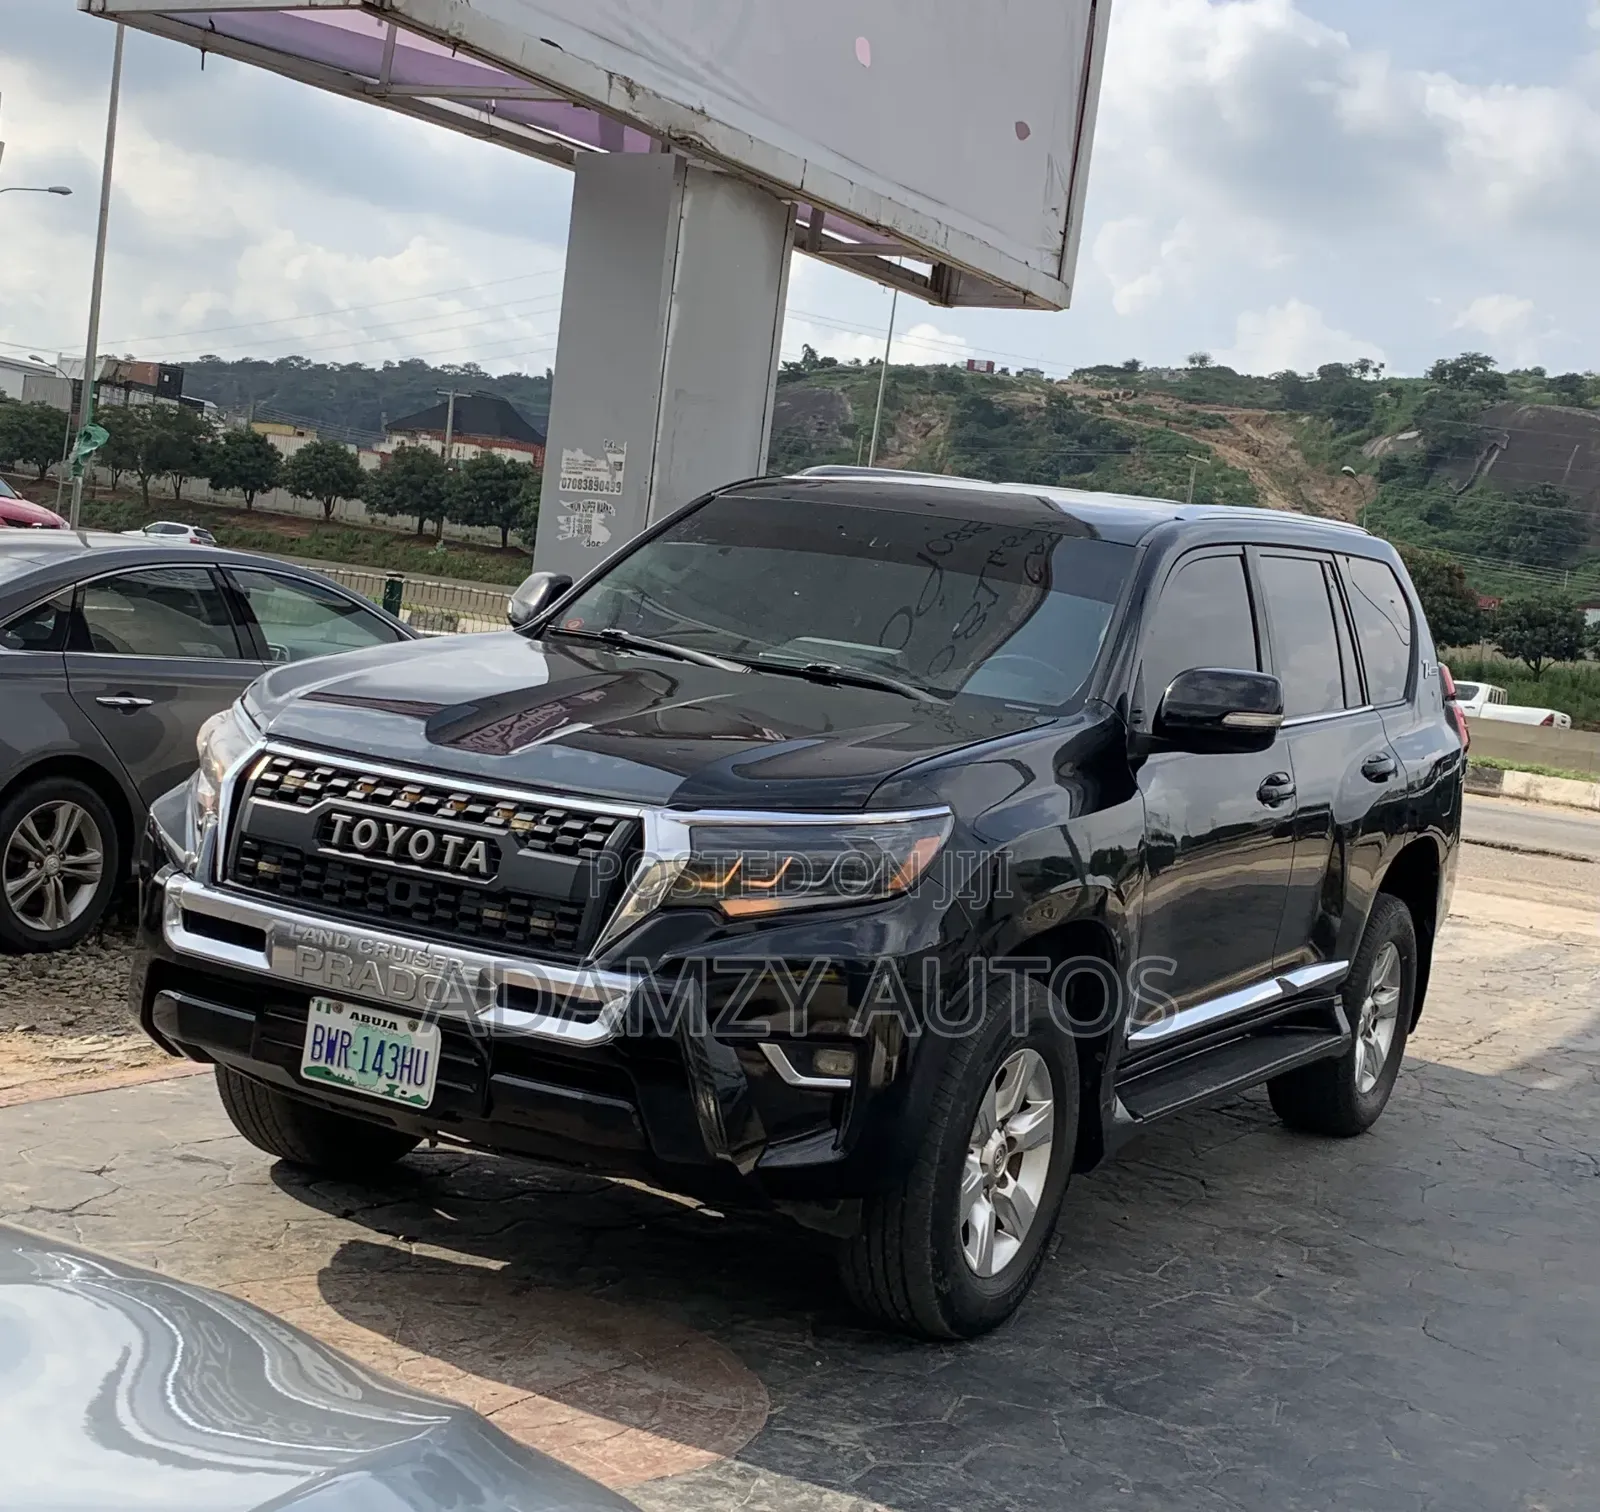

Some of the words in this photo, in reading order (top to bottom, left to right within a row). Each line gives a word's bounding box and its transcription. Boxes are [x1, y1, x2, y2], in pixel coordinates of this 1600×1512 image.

[328, 813, 490, 874] TOYOTA
[288, 924, 351, 949] LAND
[357, 938, 465, 974] CRUISER
[294, 945, 451, 1010] PRADO
[349, 1011, 398, 1031] ABUJA
[310, 1024, 429, 1087] BWR-143HU
